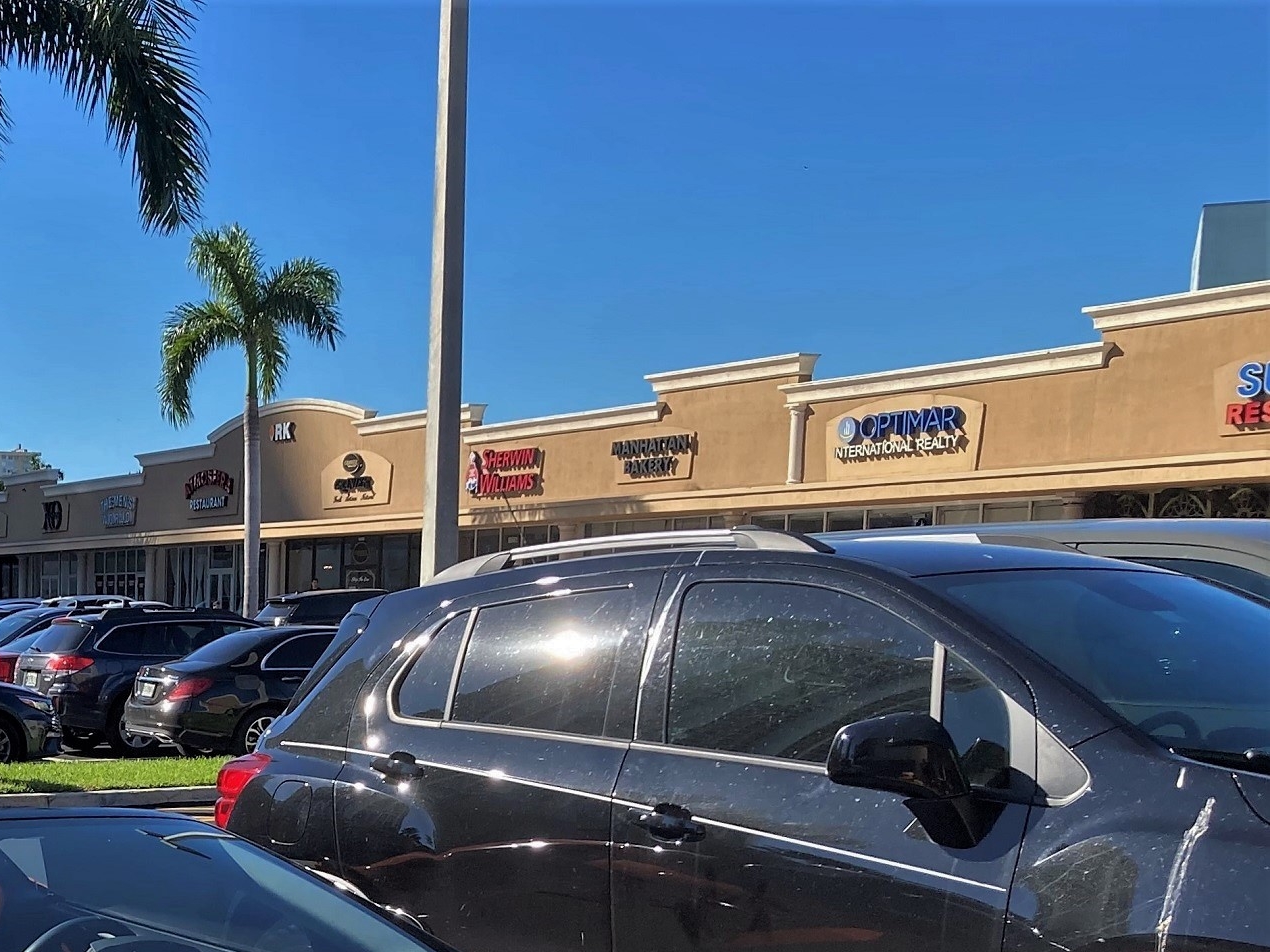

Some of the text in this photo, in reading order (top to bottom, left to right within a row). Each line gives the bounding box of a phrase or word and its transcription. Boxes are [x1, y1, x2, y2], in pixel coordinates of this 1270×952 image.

[274, 421, 292, 441] RK
[860, 406, 957, 439] OPTIMAR
[611, 434, 689, 456] MANHATTAN
[835, 435, 959, 459] INTERNATIONAL REALTY
[482, 447, 535, 469] SHERWIN
[623, 456, 672, 475] BAKERY
[480, 473, 535, 495] WILLIAMS
[189, 496, 225, 510] RESTAURANT
